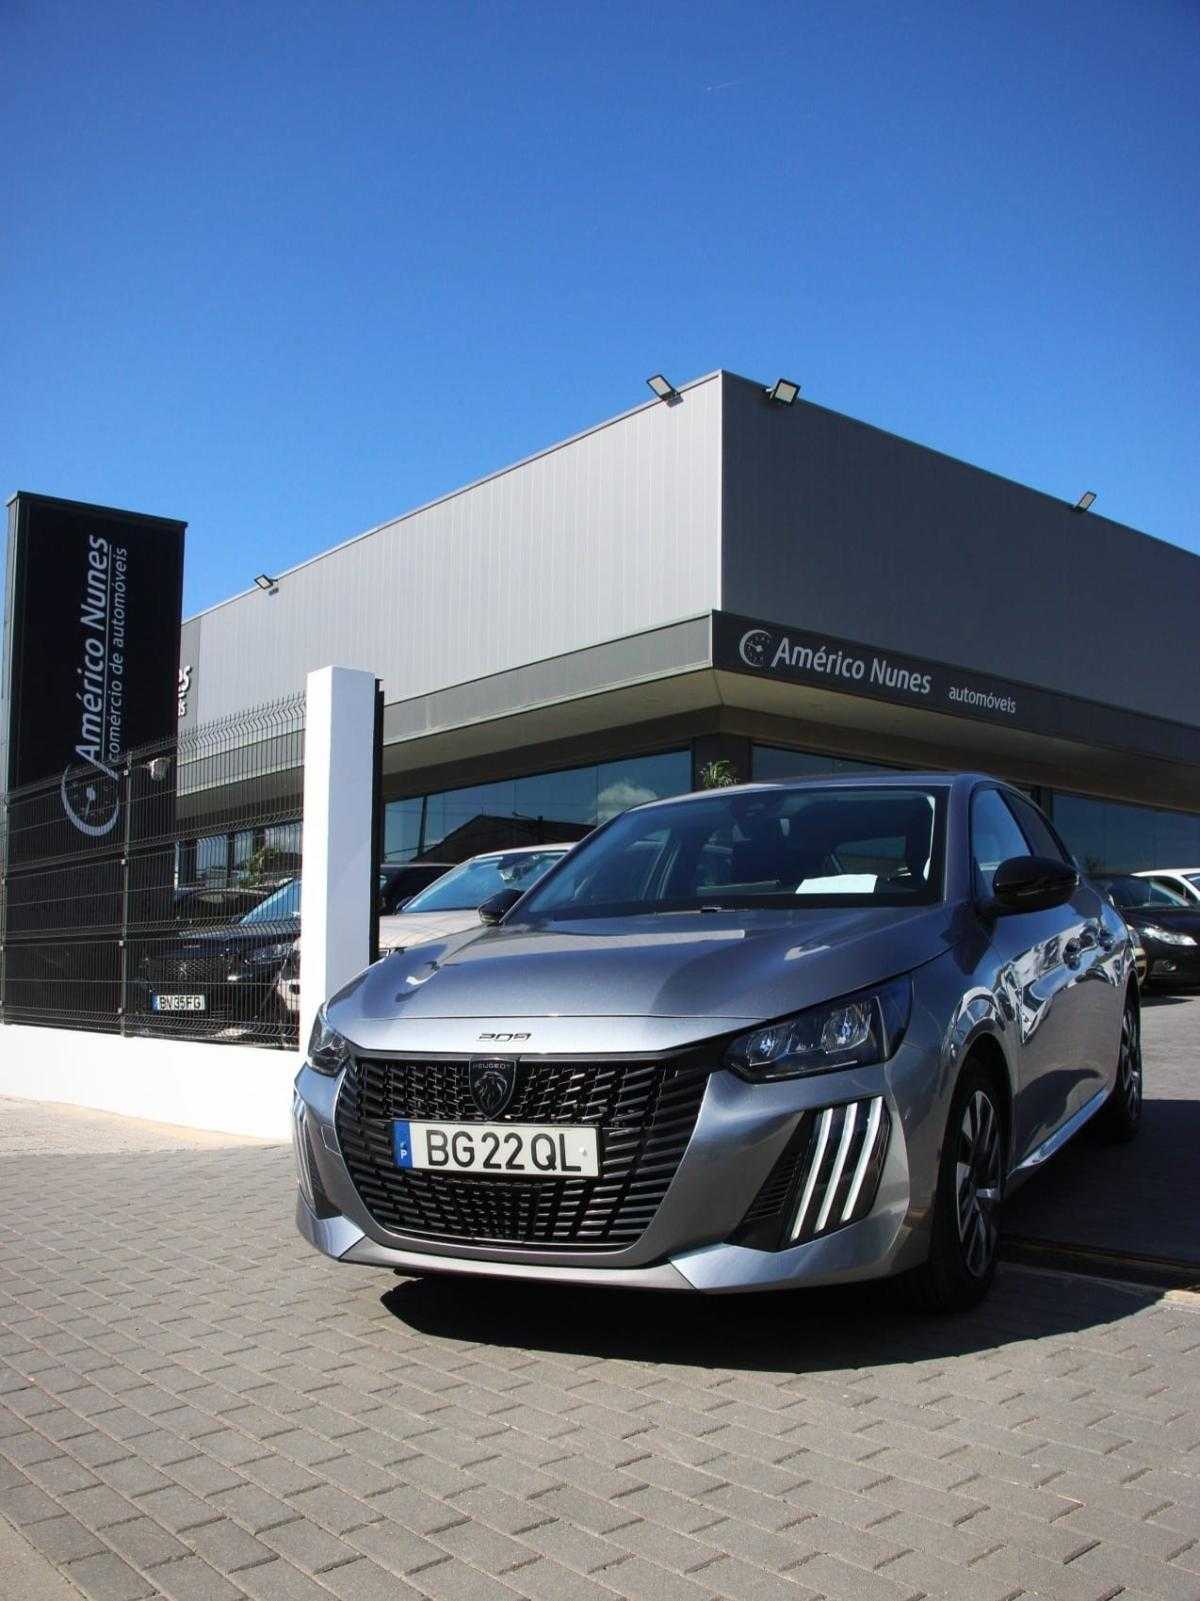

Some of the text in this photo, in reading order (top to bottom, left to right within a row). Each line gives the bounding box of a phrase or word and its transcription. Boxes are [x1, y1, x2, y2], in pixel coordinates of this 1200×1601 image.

[75, 533, 121, 781] Américo Nunes
[107, 546, 128, 764] comércio de automóveis
[770, 637, 932, 695] Américo Nunes
[948, 685, 1017, 715] automóveis
